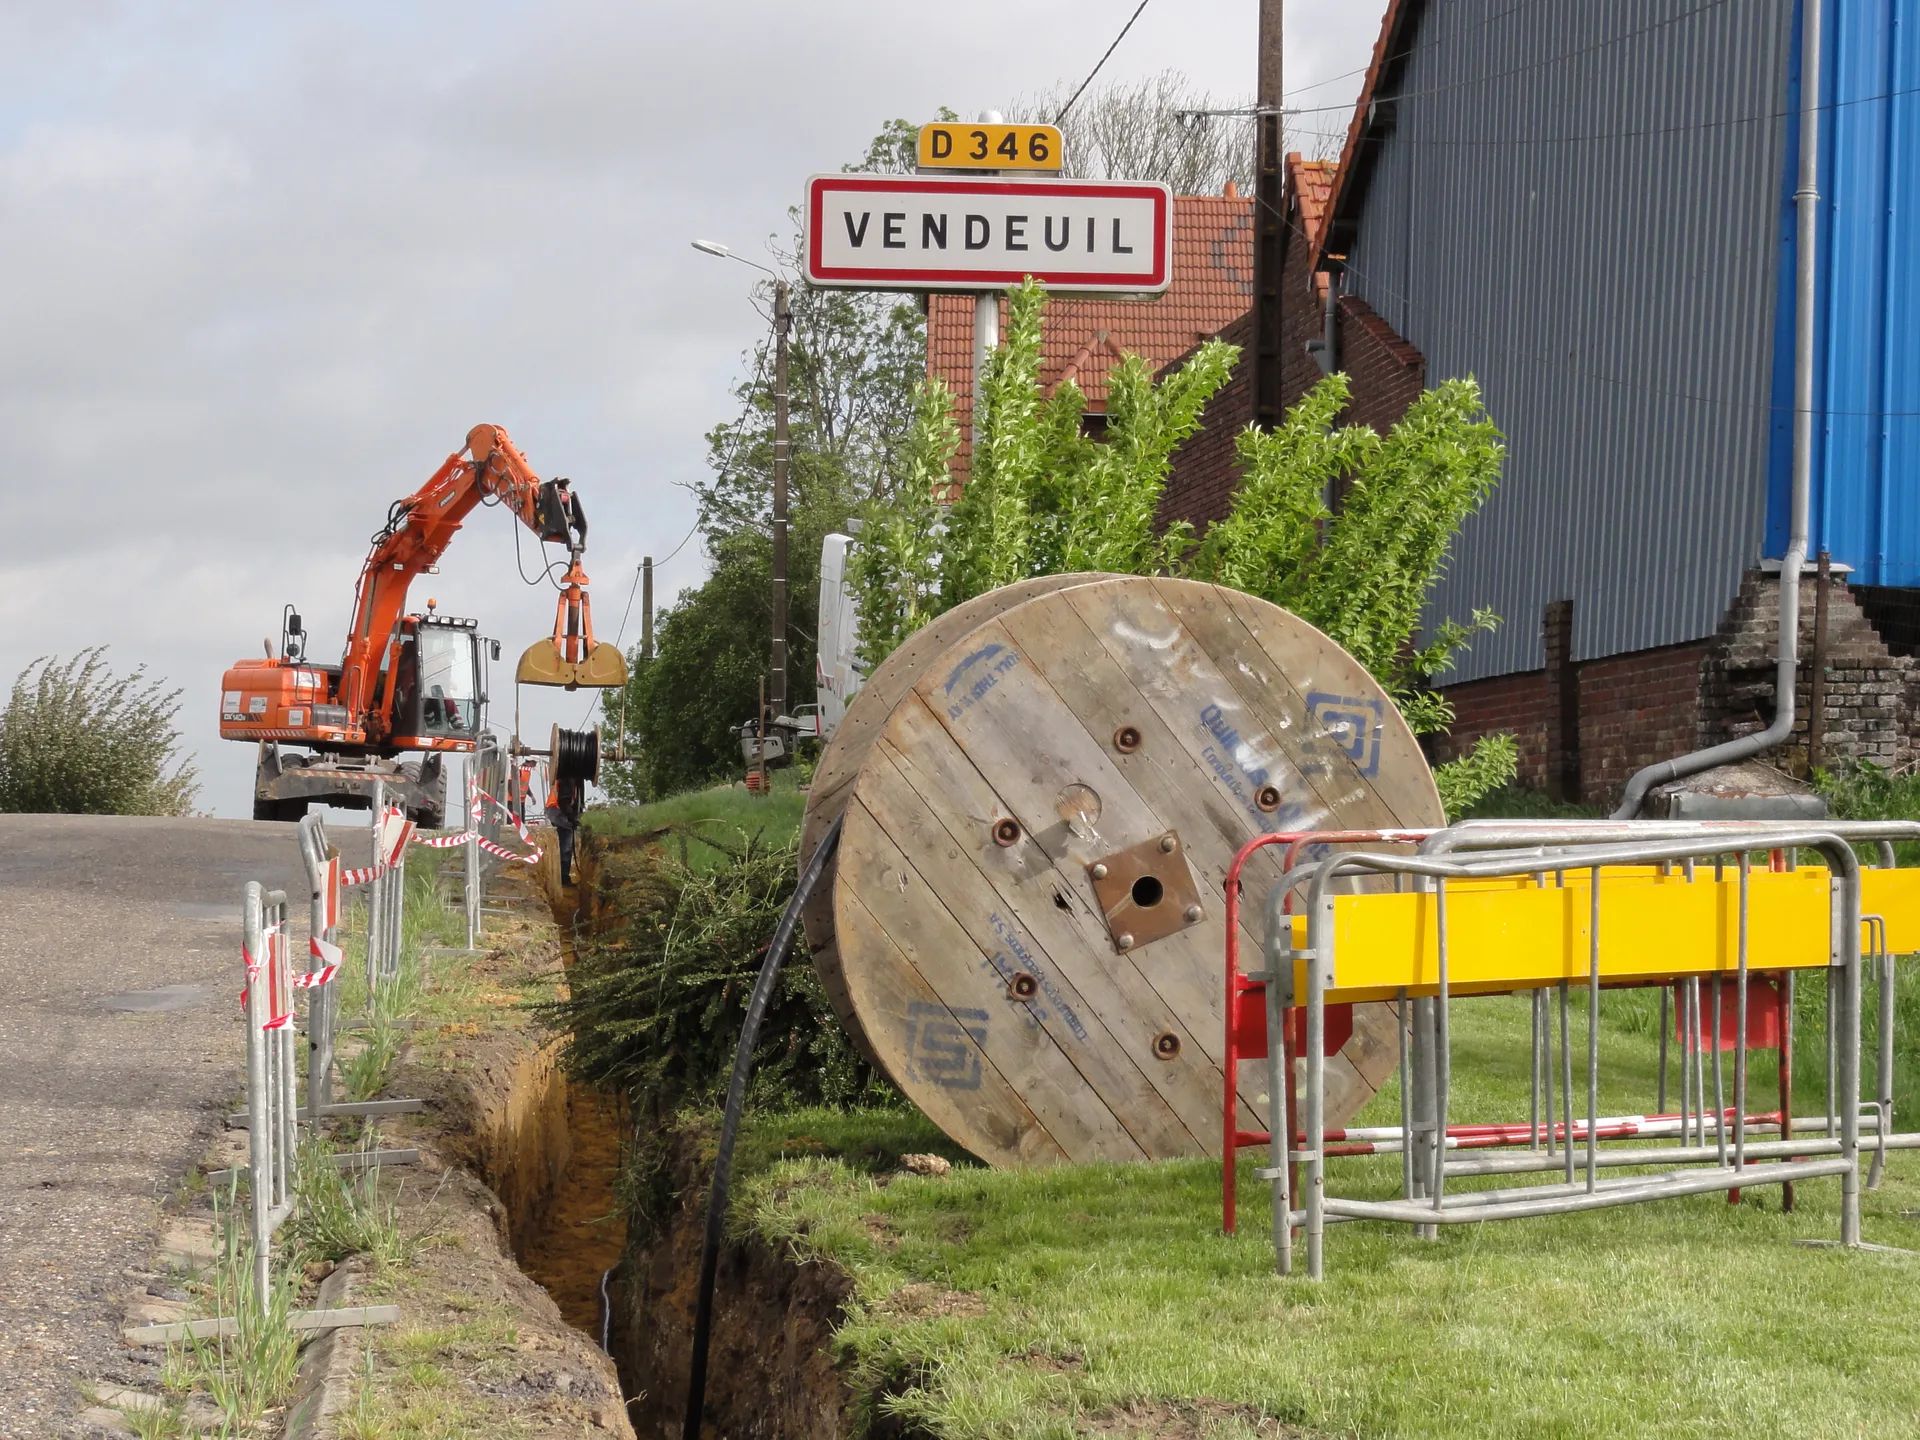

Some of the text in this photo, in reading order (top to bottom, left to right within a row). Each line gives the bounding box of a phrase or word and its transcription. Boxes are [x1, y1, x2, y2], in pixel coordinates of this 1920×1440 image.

[931, 130, 1049, 162] D 346
[844, 211, 1133, 254] VENDEUIL
